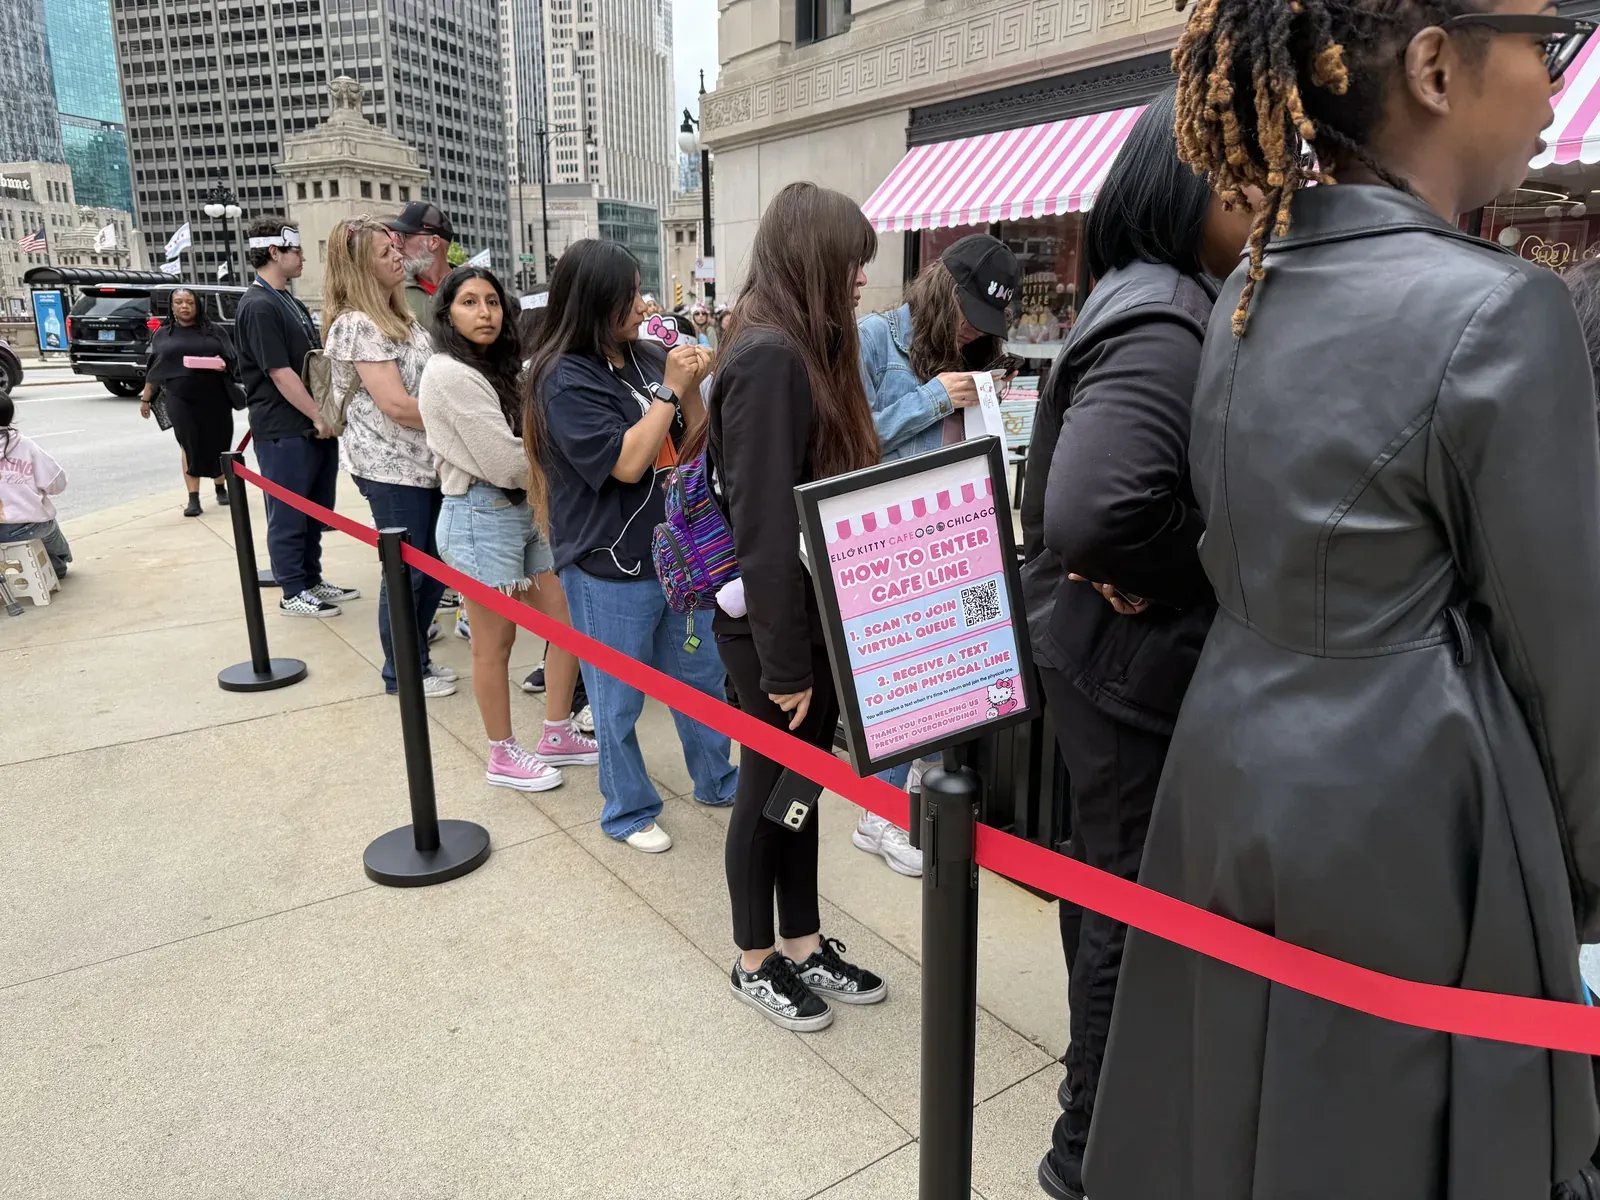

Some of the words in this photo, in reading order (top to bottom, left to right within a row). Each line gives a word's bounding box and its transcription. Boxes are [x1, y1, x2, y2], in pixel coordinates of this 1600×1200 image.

[1023, 274, 1048, 283] HELLO
[1023, 284, 1049, 294] KITTY
[858, 540, 886, 554] KITTY
[889, 532, 914, 546] CAFE
[947, 507, 996, 528] CHICAGO
[840, 558, 890, 586] HOW
[896, 549, 924, 569] TO
[930, 529, 989, 559] ENTER
[871, 575, 922, 602] CAFE
[928, 560, 969, 586] LINE
[850, 632, 860, 642] 1.
[865, 618, 901, 637] SCAN
[904, 611, 921, 625] TO
[926, 600, 957, 618] JOIN
[857, 632, 912, 656] VIRTUAL
[915, 617, 957, 637] QUEUE
[865, 694, 883, 707] TO
[887, 683, 918, 700] JOIN
[921, 662, 981, 689] PHYSICAL
[984, 651, 1010, 666] LINE
[877, 676, 890, 687] 2.
[893, 657, 944, 682] RECEIVE
[947, 654, 957, 664] A
[959, 641, 988, 660] TEXT
[884, 706, 900, 714] receive
[913, 697, 926, 706] when
[949, 685, 962, 693] return
[962, 681, 971, 689] and
[971, 678, 979, 688] join
[987, 670, 1005, 681] physical
[869, 726, 897, 741] THANK
[899, 720, 916, 731] YOU
[918, 715, 933, 725] FOR
[934, 703, 967, 722] HELPING
[969, 698, 979, 707] US
[874, 732, 909, 750] PREVENT
[911, 709, 978, 737] OVERCROWDING!
